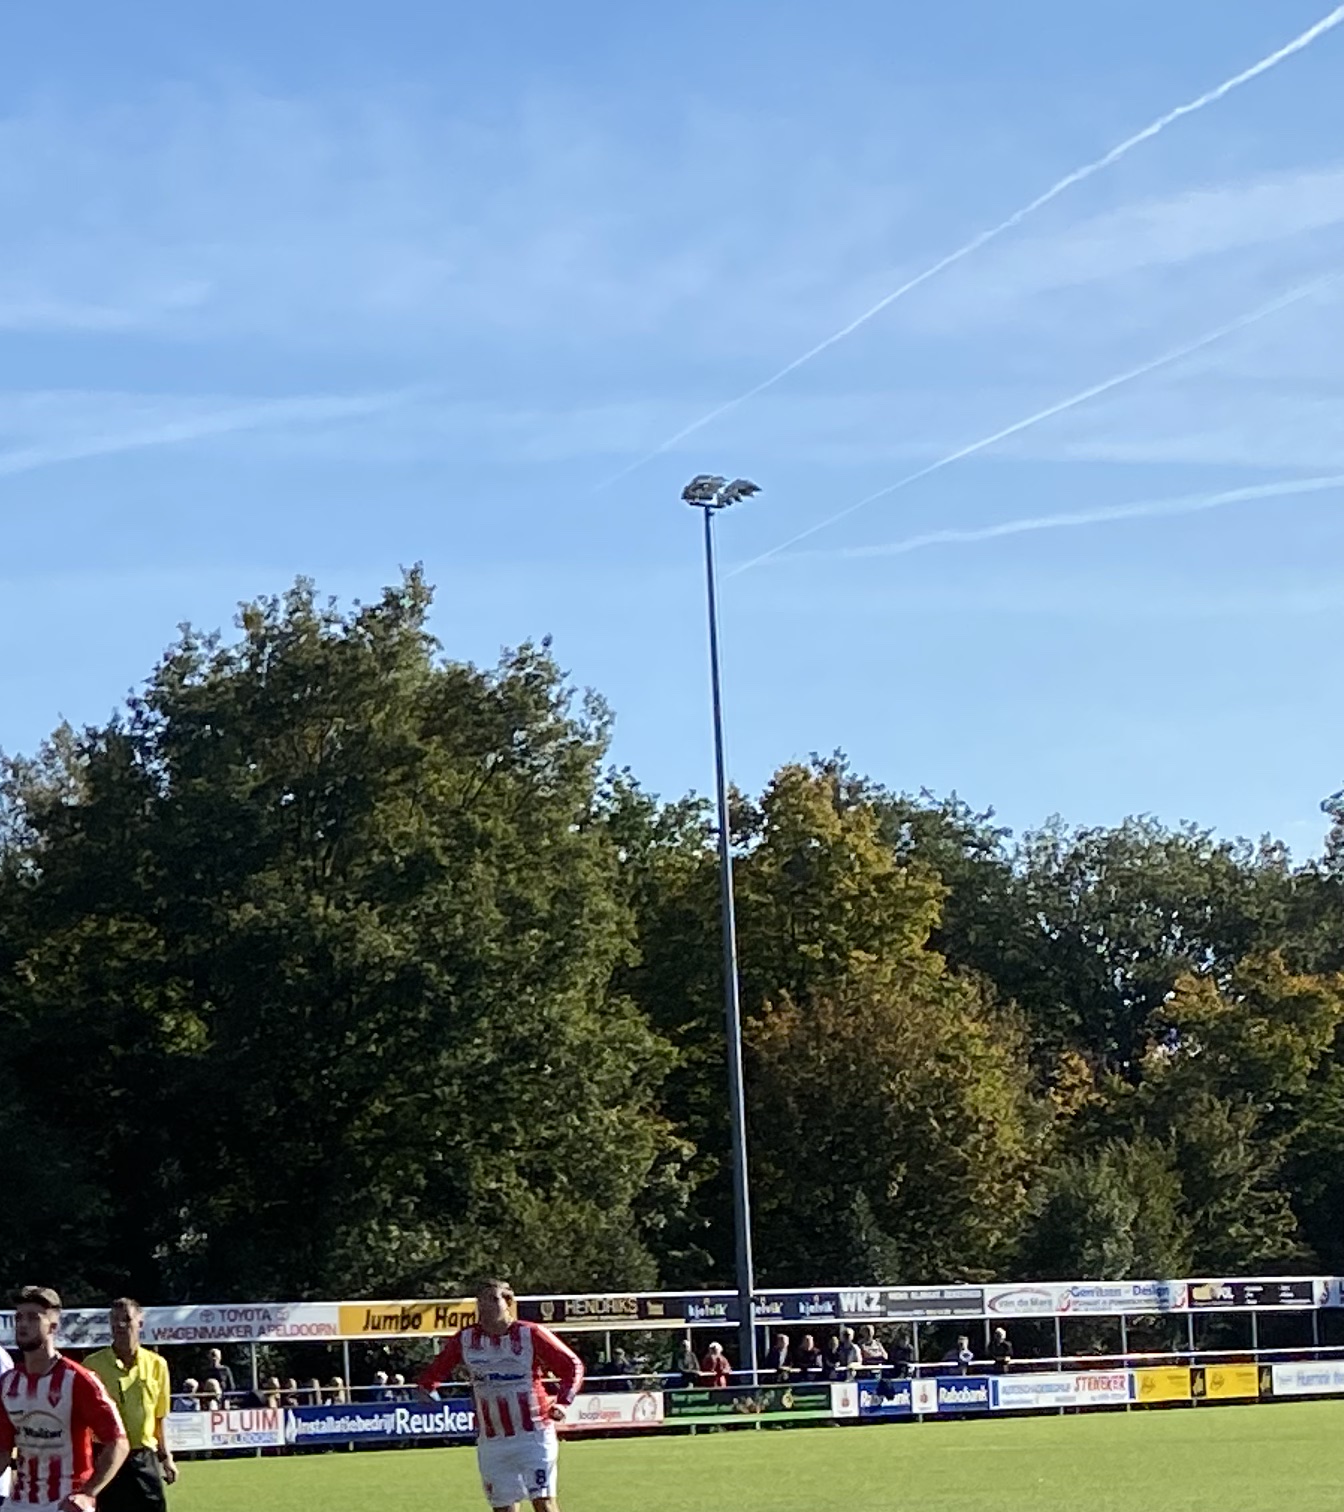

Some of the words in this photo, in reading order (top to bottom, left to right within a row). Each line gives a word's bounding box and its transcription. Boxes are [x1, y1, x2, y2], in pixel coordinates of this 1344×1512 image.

[839, 1292, 881, 1312] WKZ
[219, 1309, 271, 1323] TOYOTA
[363, 1307, 422, 1331] Jumbo
[152, 1325, 253, 1341] WAGENMAKER
[257, 1324, 337, 1338] APELDOORN
[211, 1410, 279, 1433] PLUIM
[297, 1410, 395, 1436] Installatiebedrijf
